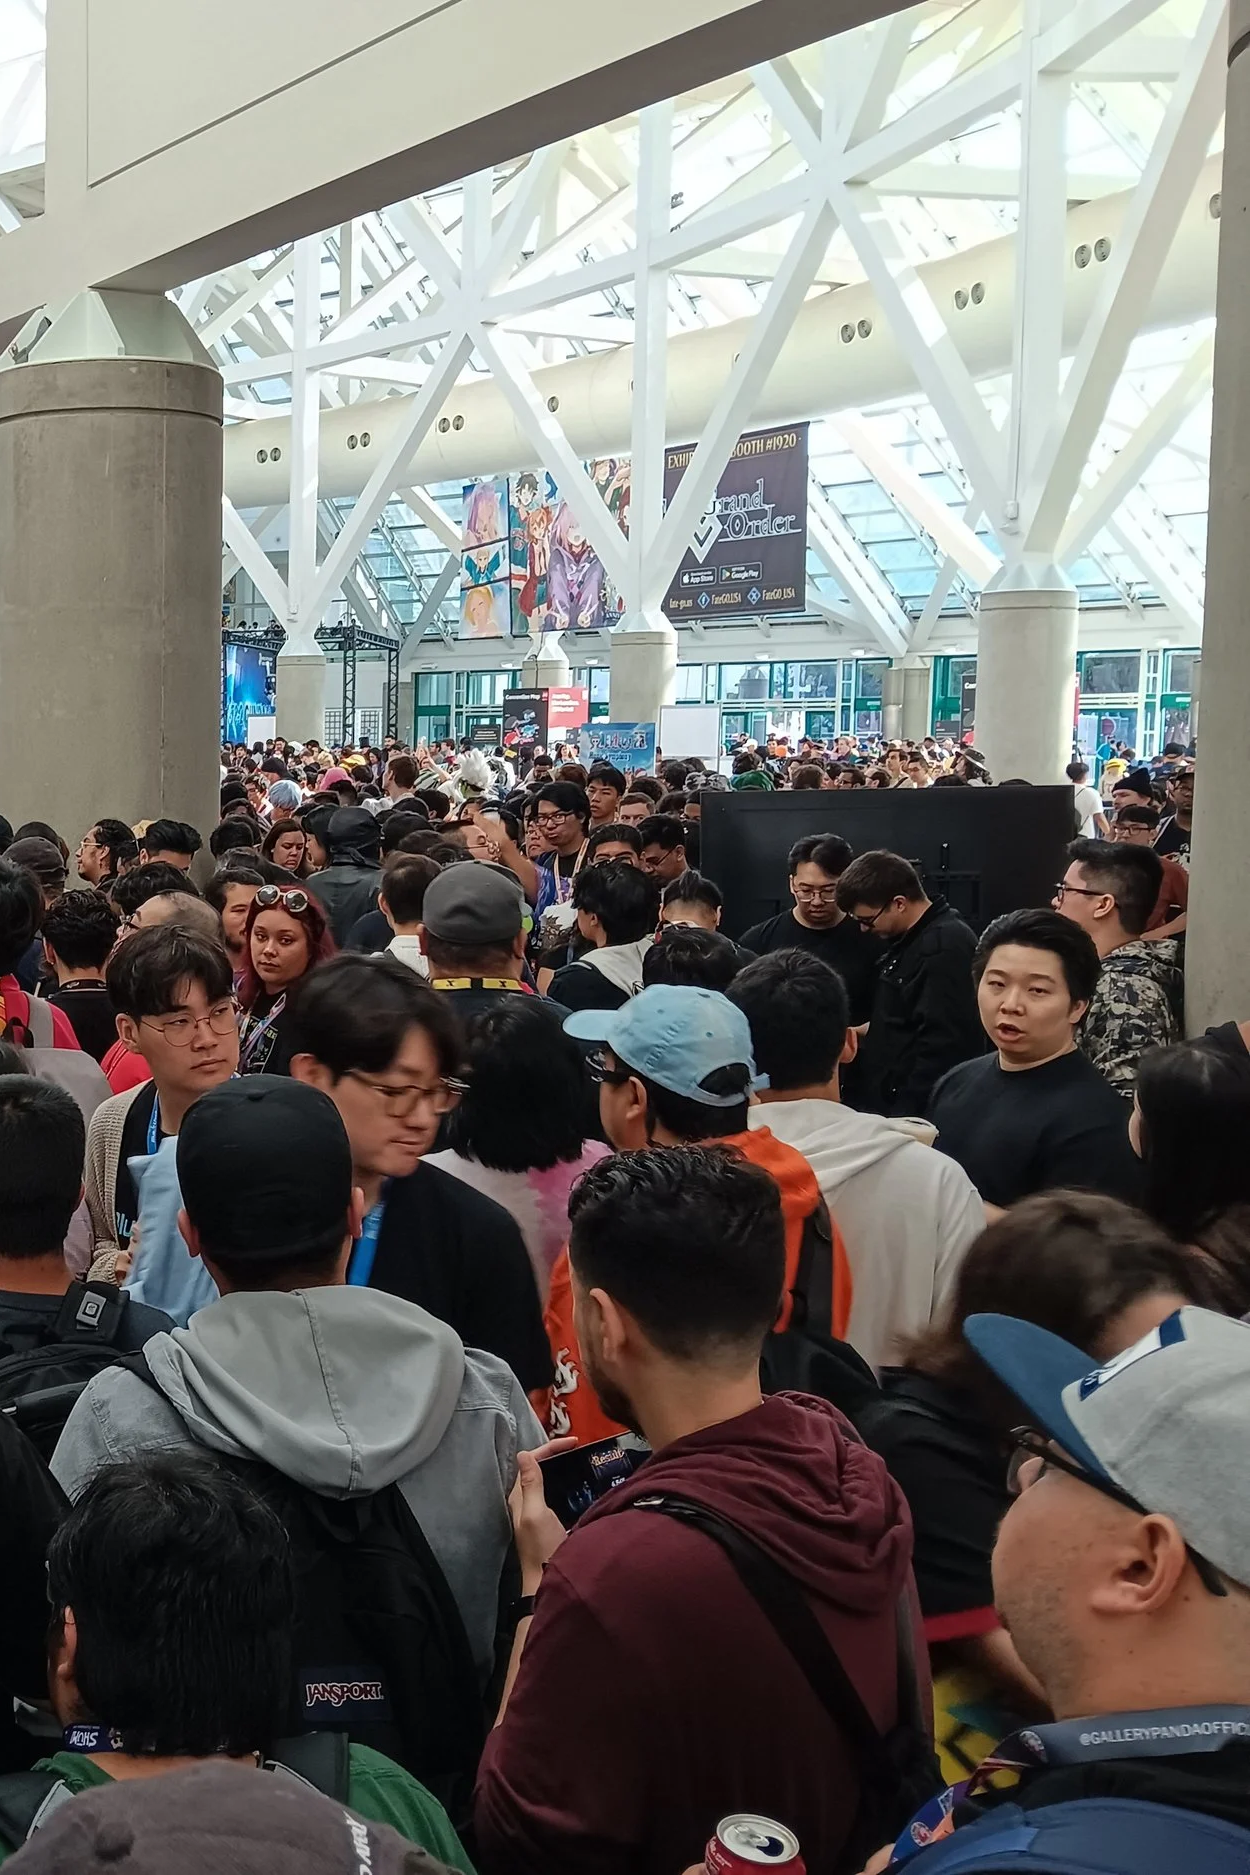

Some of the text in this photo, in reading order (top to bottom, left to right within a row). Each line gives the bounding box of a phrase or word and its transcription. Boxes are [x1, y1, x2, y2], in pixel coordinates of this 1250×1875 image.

[766, 432, 797, 451] #1920
[726, 506, 797, 539] Order
[690, 576, 701, 584] App
[701, 573, 714, 582] Store
[731, 570, 749, 580] Google
[749, 568, 759, 578] Play
[305, 1682, 382, 1707] JANSPORT
